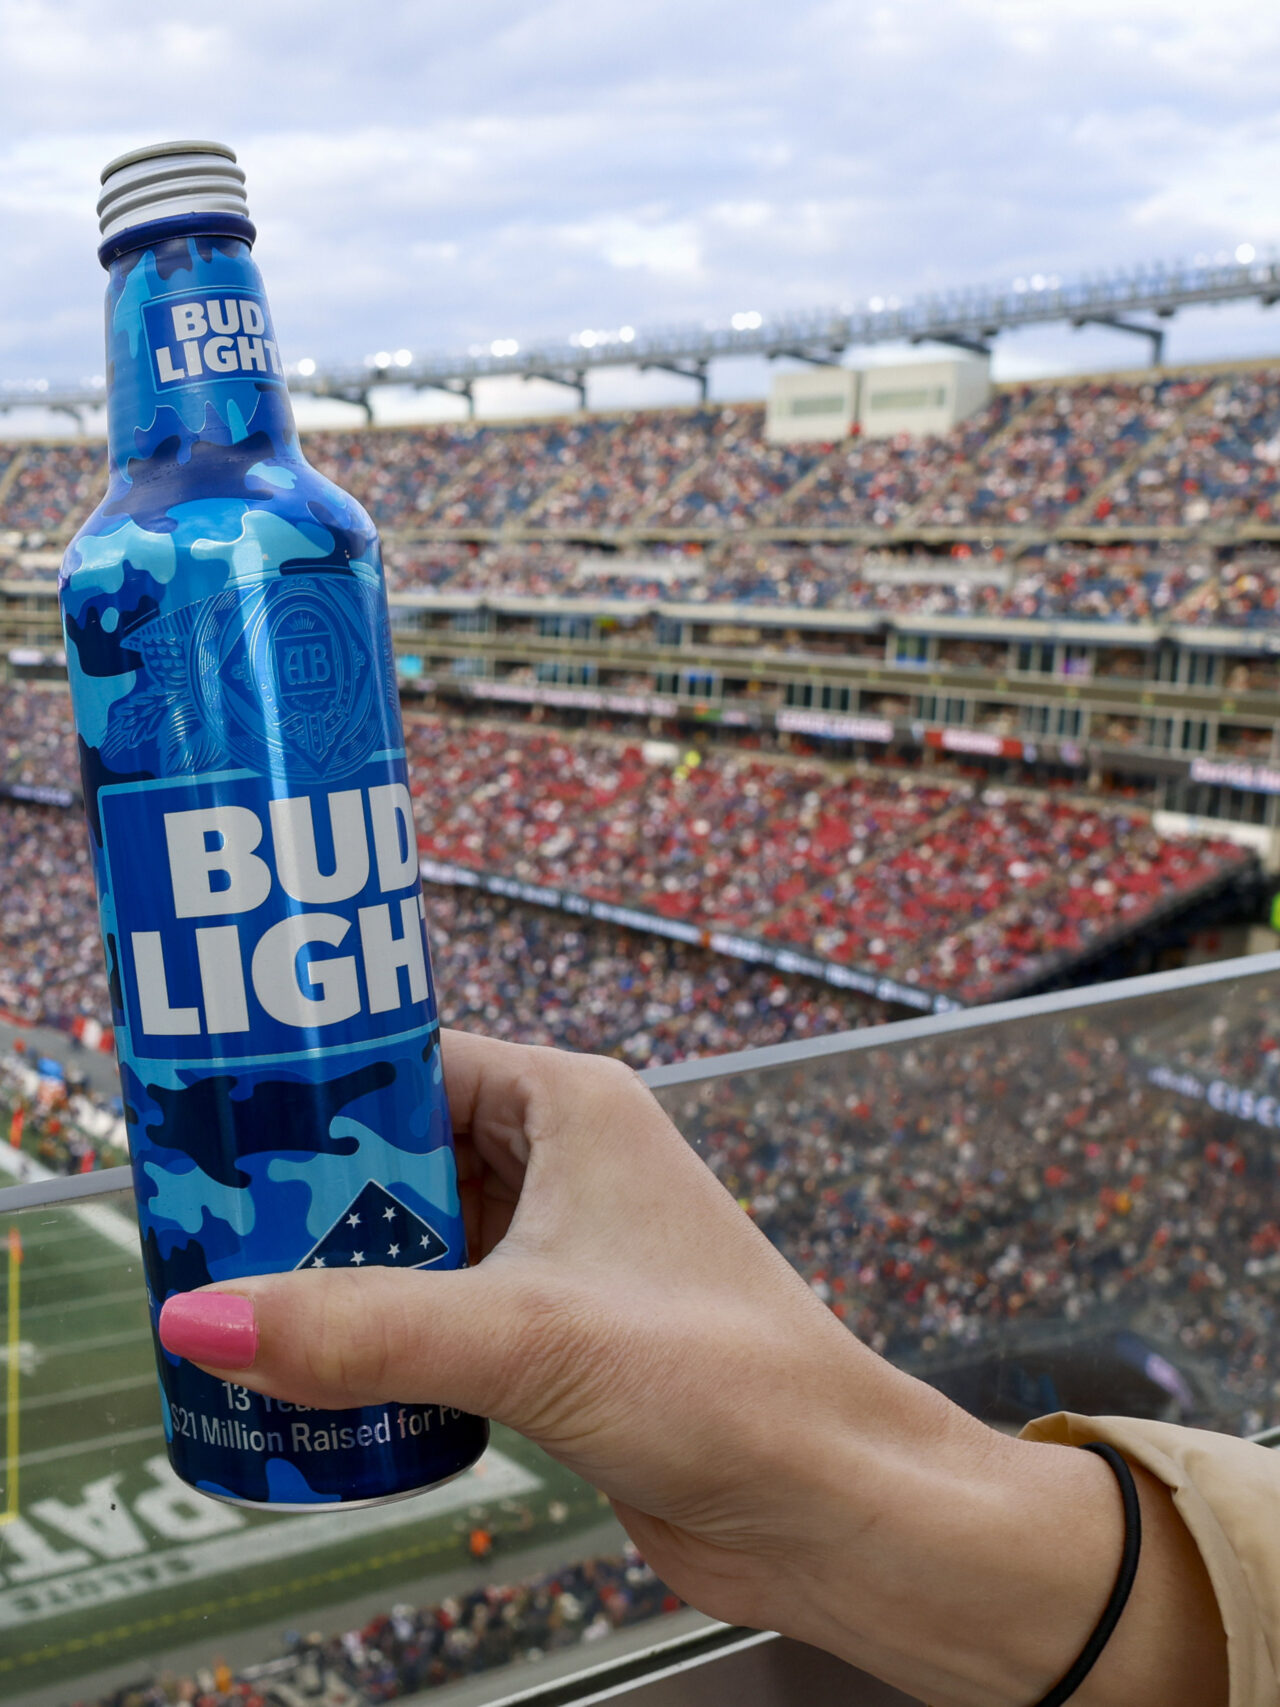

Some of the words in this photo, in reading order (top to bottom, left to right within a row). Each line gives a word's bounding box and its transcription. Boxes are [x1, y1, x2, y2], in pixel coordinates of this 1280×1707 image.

[171, 299, 265, 341] BUD
[156, 336, 282, 384] LIGHT
[163, 782, 419, 919] BUD
[131, 895, 429, 1036] LIGH
[222, 1381, 252, 1412] 13
[201, 1413, 285, 1453] Million
[291, 1412, 391, 1453] Raised
[397, 1408, 433, 1440] for
